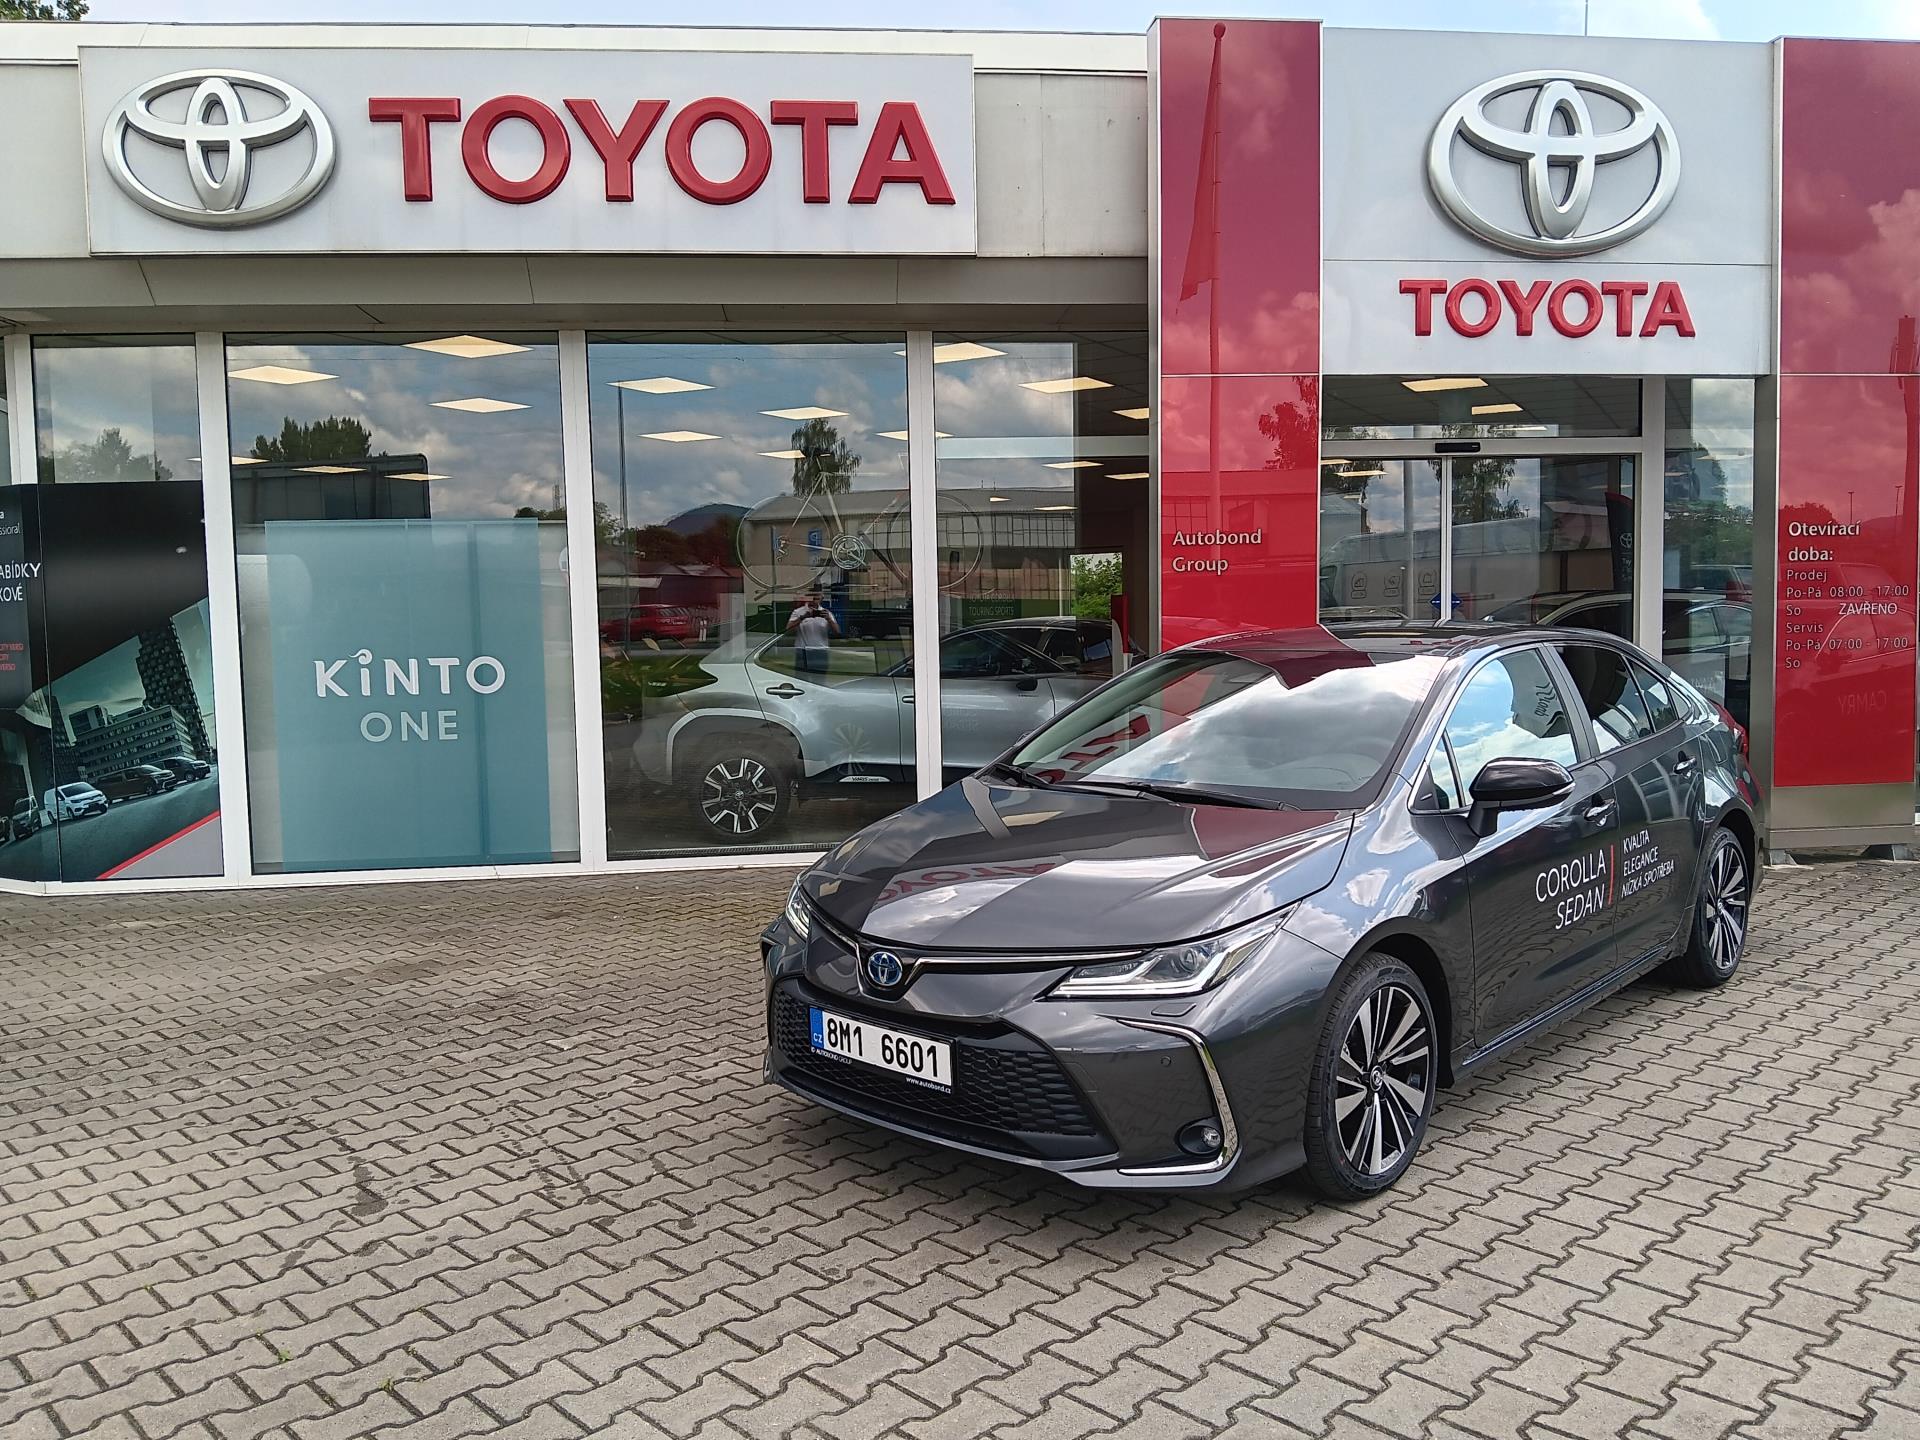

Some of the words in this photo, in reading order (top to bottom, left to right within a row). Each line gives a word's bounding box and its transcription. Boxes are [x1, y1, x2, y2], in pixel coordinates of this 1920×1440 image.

[368, 95, 957, 205] TOYOTA
[1399, 278, 1696, 338] TOYOTA
[1172, 528, 1262, 546] Autobond
[1788, 520, 1861, 537] Otevírací
[1788, 546, 1833, 561] doba:
[1172, 556, 1229, 575] Group
[1786, 569, 1827, 583] Prodej
[1786, 586, 1822, 598] Po-Pá
[1829, 586, 1864, 597] 08:00
[1877, 585, 1909, 596] 17:00
[1786, 604, 1801, 616] So
[1838, 600, 1898, 615] ZAVŘENO
[1786, 622, 1824, 633] Servis
[1786, 639, 1821, 651] Po-Pá
[1829, 638, 1862, 650] 07:00
[1876, 637, 1908, 649] 17:00
[1785, 657, 1801, 669] So
[360, 710, 458, 742] ONE
[1623, 829, 1650, 854] KVALITA
[1623, 846, 1658, 877] ELEGANCE
[1536, 850, 1606, 902] COROLLA
[1621, 871, 1643, 898] NÍZKÁ
[1555, 884, 1605, 930] SEDAN
[813, 1032, 823, 1044] CZ
[827, 1018, 864, 1057] 8M1
[881, 1033, 938, 1078] 6601
